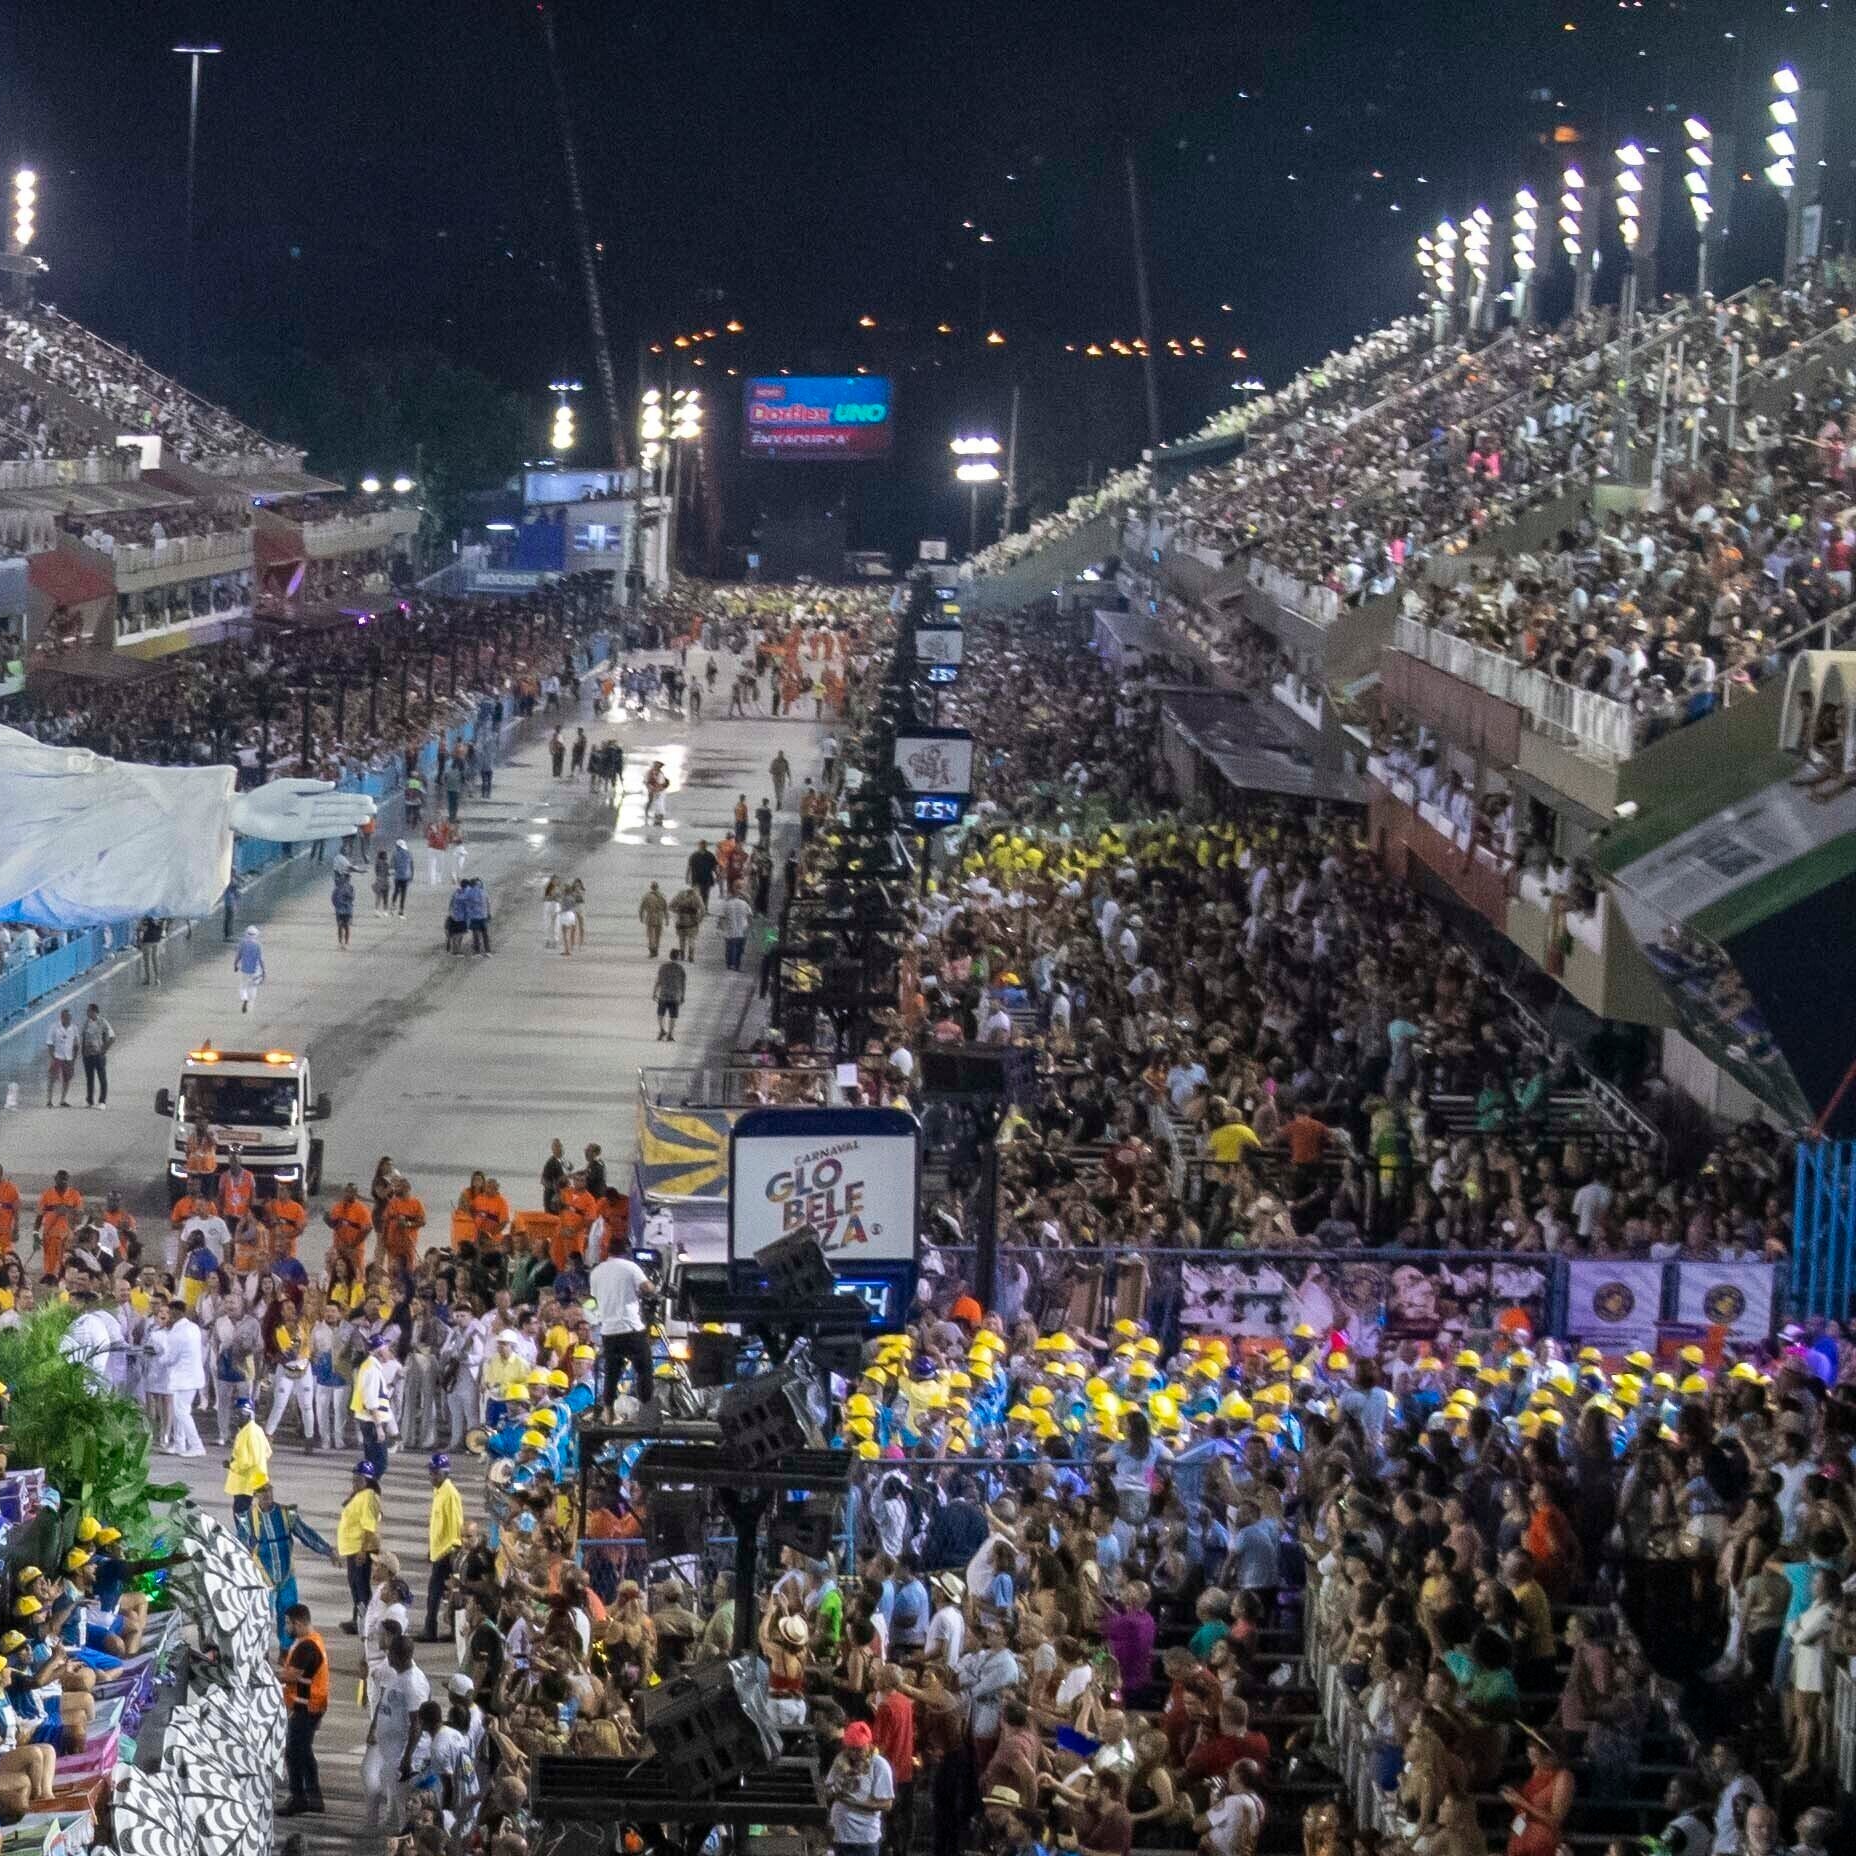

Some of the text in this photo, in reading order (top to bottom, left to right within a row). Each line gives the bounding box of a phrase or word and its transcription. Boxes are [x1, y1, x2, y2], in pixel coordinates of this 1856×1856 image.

[834, 403, 887, 422] UNO
[765, 1158, 843, 1202] GLO
[783, 1181, 865, 1231] BELE
[817, 1214, 869, 1251] ZA
